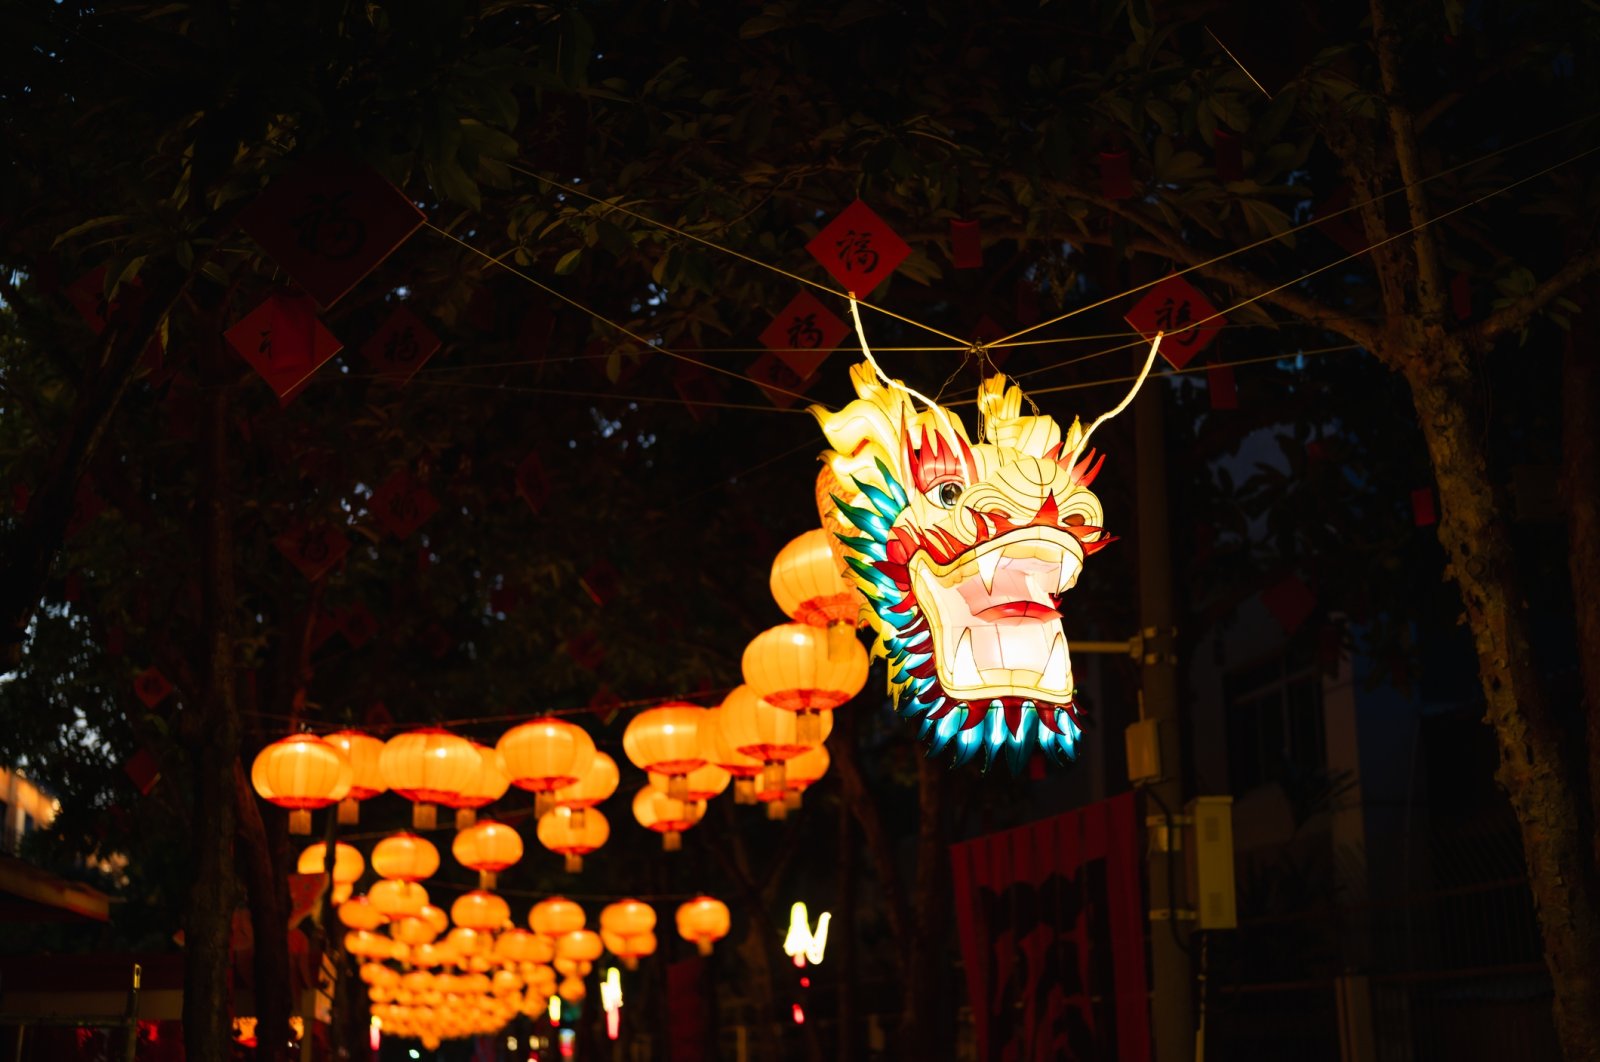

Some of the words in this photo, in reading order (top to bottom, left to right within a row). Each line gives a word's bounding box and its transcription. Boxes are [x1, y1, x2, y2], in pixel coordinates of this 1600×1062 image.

[289, 189, 367, 261] 福
[836, 229, 879, 274] 福
[787, 313, 824, 348] 福
[1154, 298, 1200, 348] 福
